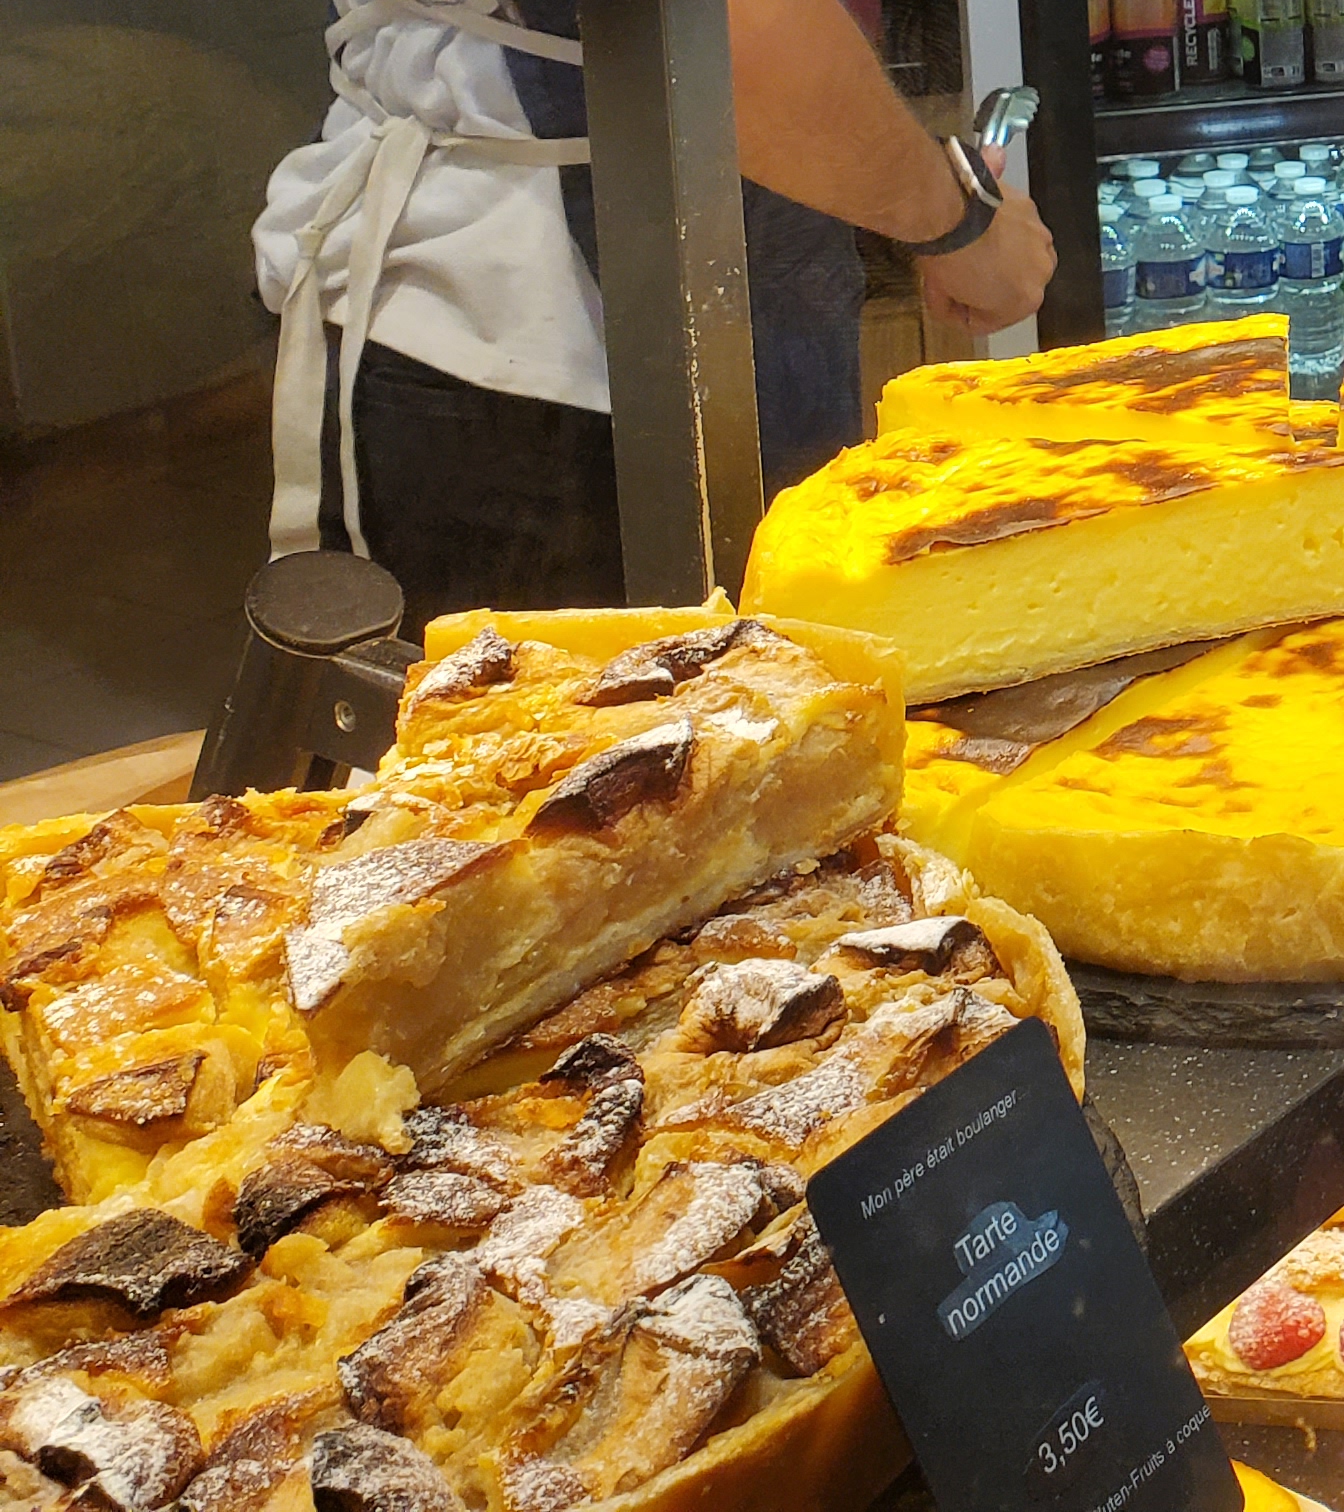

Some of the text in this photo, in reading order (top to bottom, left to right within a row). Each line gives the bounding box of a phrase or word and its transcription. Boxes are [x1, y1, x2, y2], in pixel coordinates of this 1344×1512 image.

[861, 1189, 893, 1220] Mon
[895, 1161, 925, 1199] père
[926, 1137, 956, 1170] était
[954, 1209, 1019, 1268] Tarte
[946, 1228, 1061, 1337] normande
[1038, 1395, 1106, 1474] 3,50€
[1093, 1450, 1166, 1512] luten-Fruits
[1165, 1438, 1177, 1456] à
